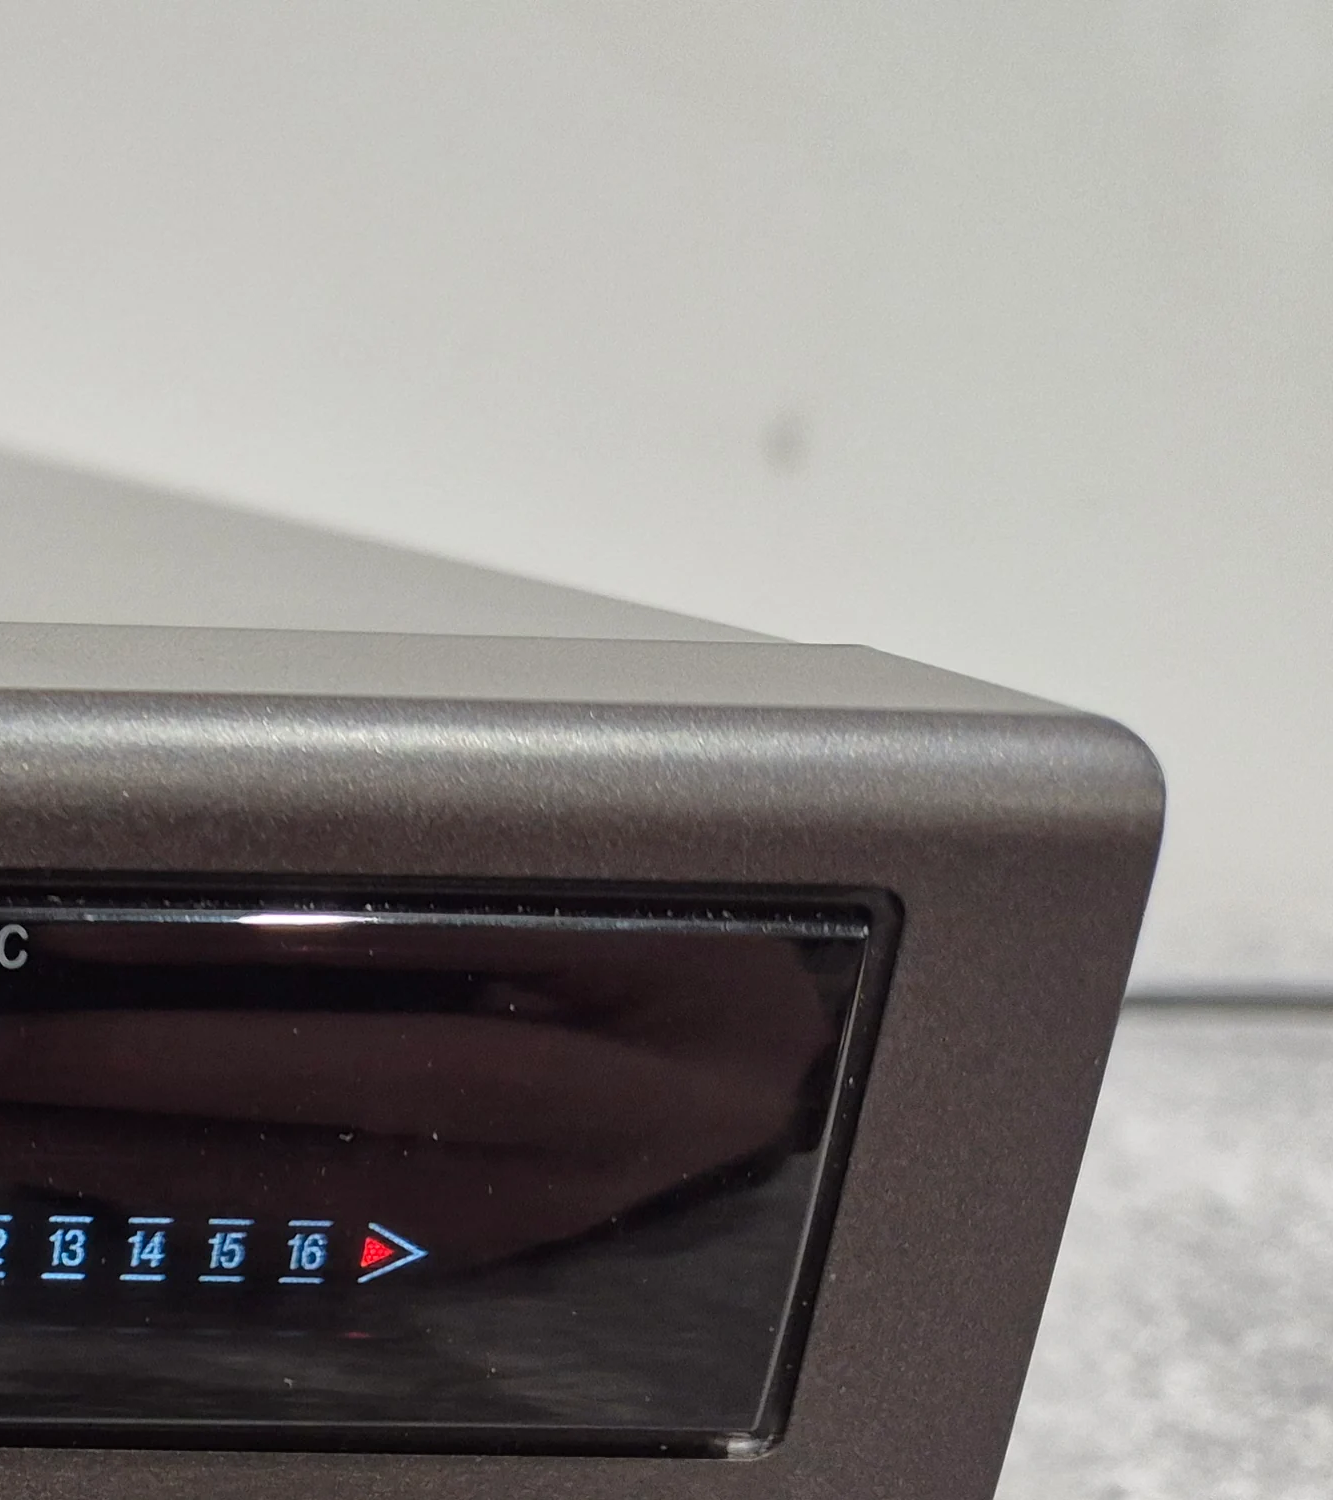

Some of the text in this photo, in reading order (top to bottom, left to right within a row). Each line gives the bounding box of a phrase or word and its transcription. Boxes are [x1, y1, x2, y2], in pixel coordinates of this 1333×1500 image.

[49, 1228, 87, 1267] 13
[128, 1230, 165, 1268] 14
[208, 1232, 246, 1269] 15
[287, 1233, 327, 1270] 16
